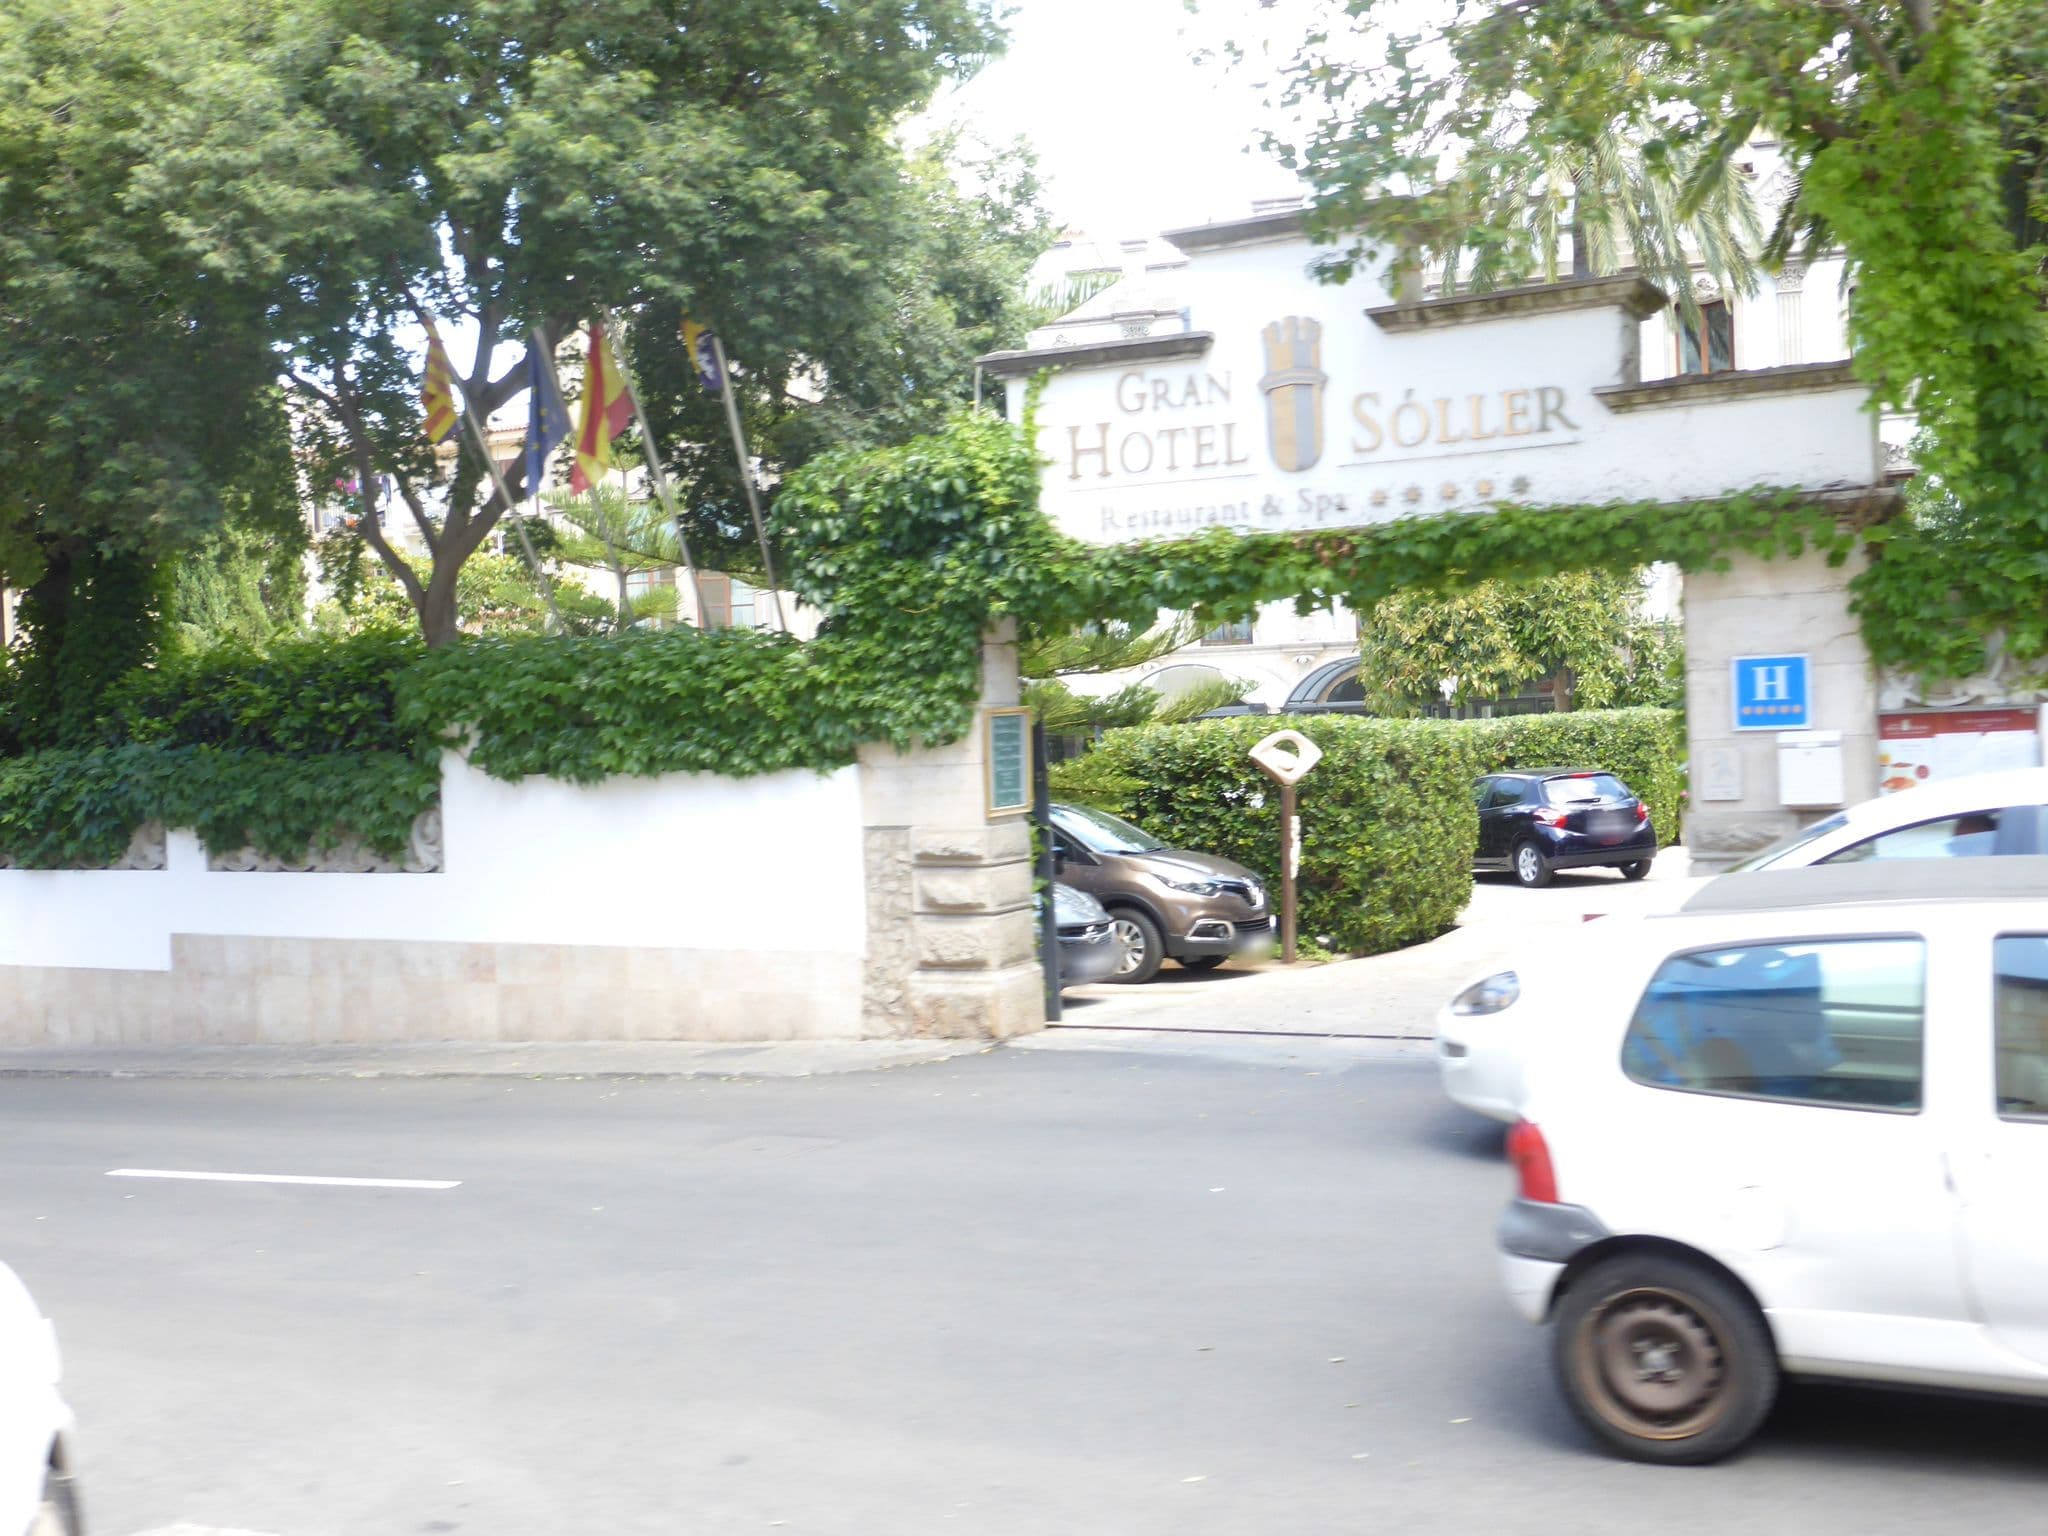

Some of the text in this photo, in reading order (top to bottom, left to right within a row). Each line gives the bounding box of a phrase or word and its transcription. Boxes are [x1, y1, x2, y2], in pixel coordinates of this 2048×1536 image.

[1116, 370, 1233, 415] GRAN
[1352, 385, 1580, 454] SÓLLER
[1066, 421, 1249, 480] HOTEL
[1101, 487, 1349, 532] Restaurant & Spa
[1751, 665, 1792, 701] H
